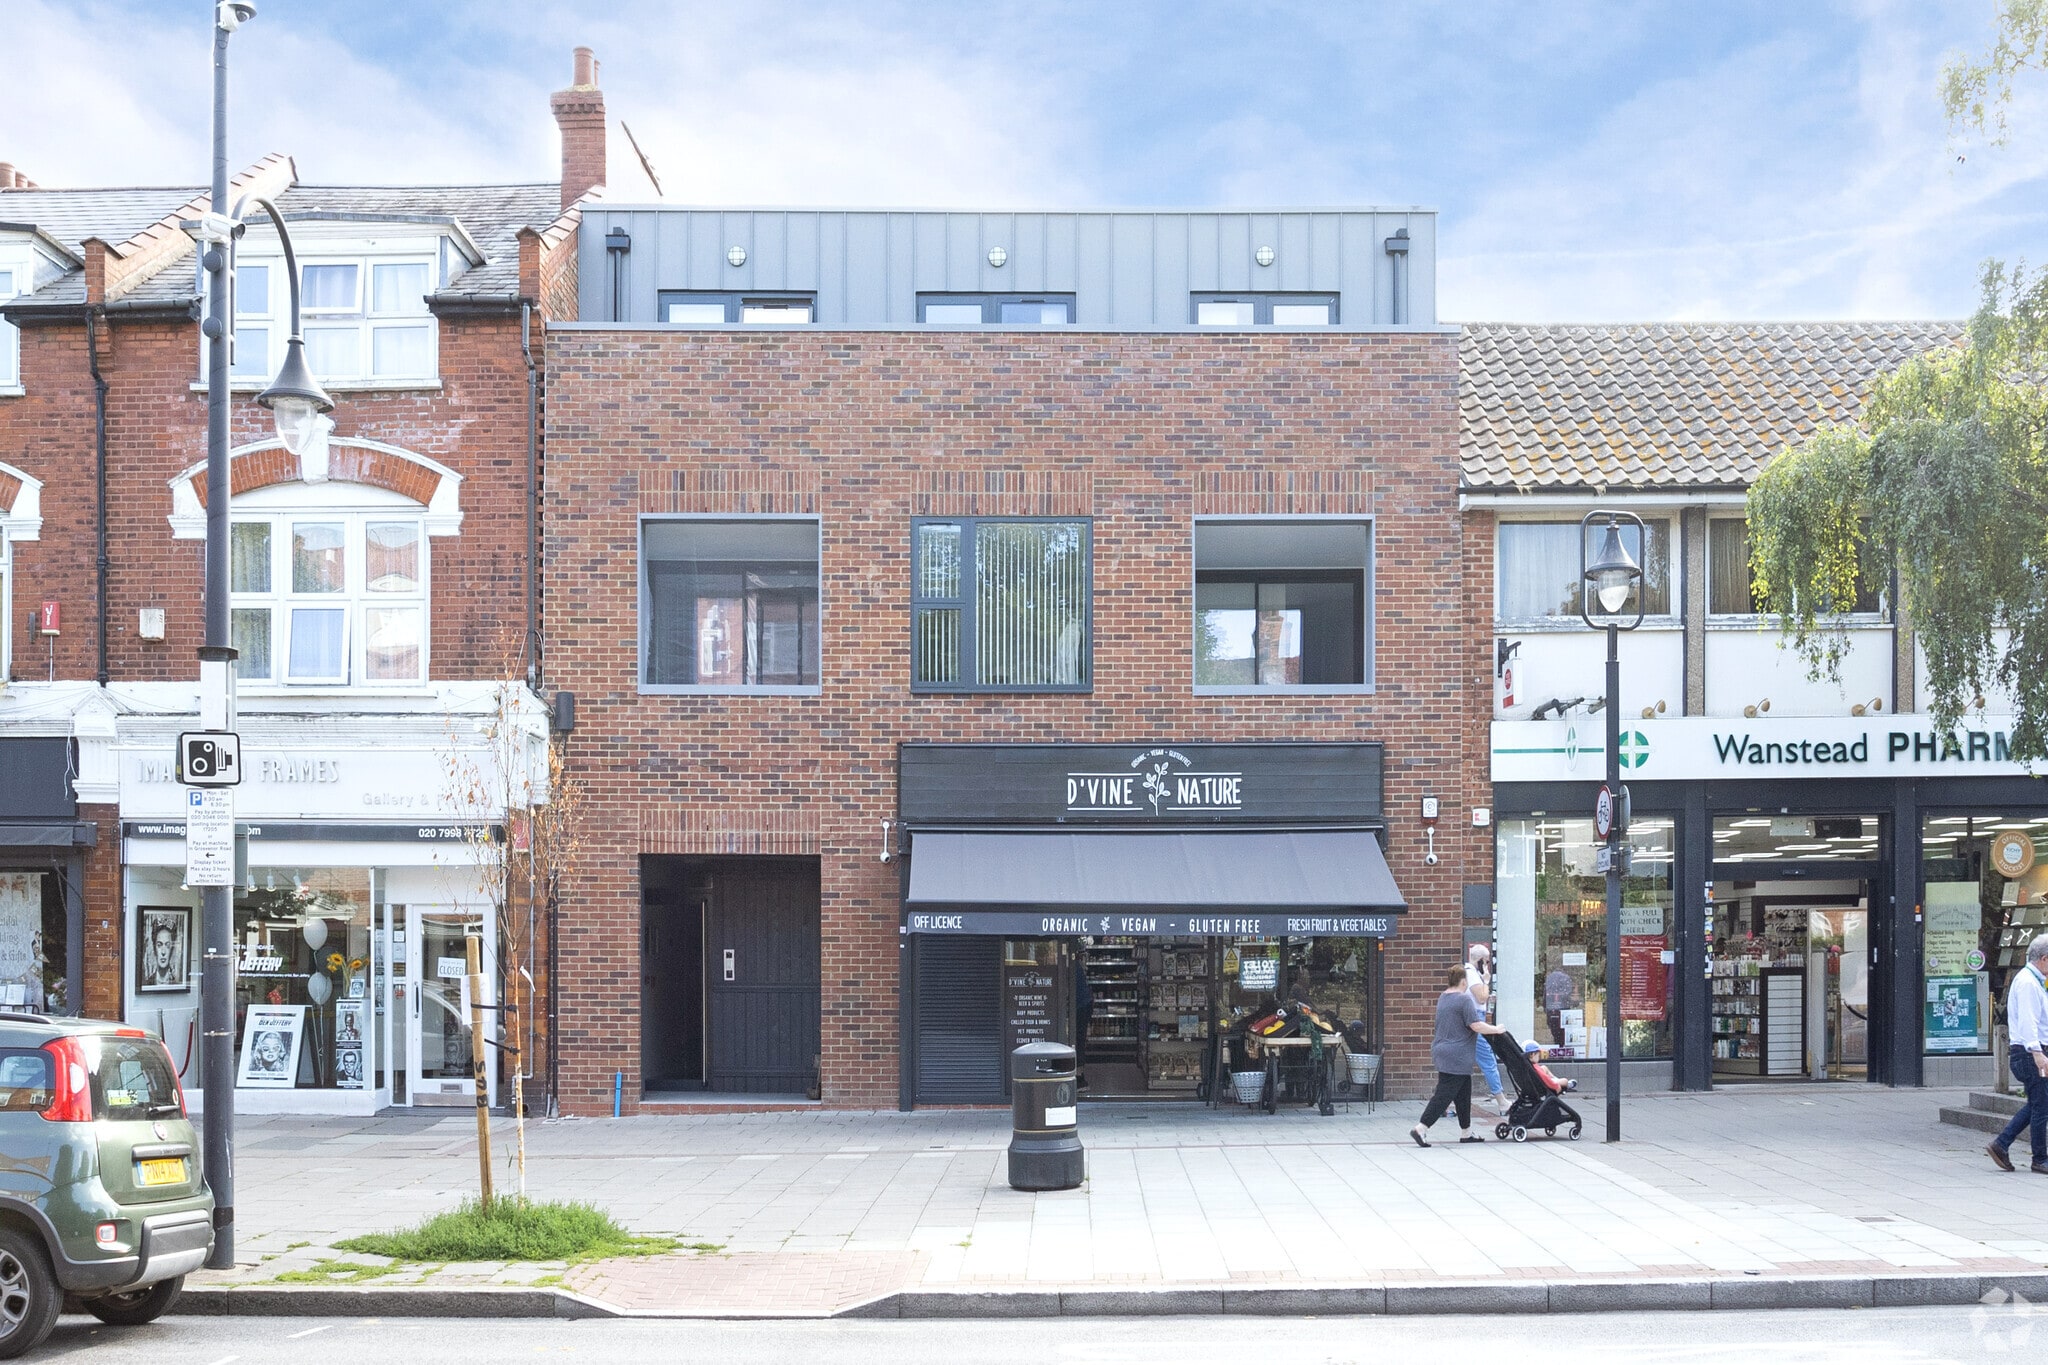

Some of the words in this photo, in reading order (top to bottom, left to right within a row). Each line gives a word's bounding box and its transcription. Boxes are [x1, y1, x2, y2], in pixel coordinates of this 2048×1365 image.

[1713, 732, 1868, 763] Wanstead
[1889, 732, 2047, 762] PHARM
[260, 759, 340, 783] FRAMES
[1067, 778, 1134, 805] D'VINE
[1177, 778, 1242, 804] NATURE
[363, 793, 414, 808] Gallery
[418, 828, 437, 838] 020
[914, 916, 930, 928] OFF
[931, 916, 962, 929] LICENCE
[1042, 918, 1088, 932] ORGANIC
[1121, 918, 1156, 932] VEGAN
[1189, 919, 1230, 933] GLUTEN
[1235, 919, 1260, 933] FREE
[1287, 918, 1310, 932] FRESH
[1312, 919, 1333, 932] FRUIT
[1333, 920, 1339, 931] &
[1340, 919, 1387, 932] VEGETABLES
[1638, 917, 1662, 925] CHECK
[440, 965, 464, 976] CLOSED
